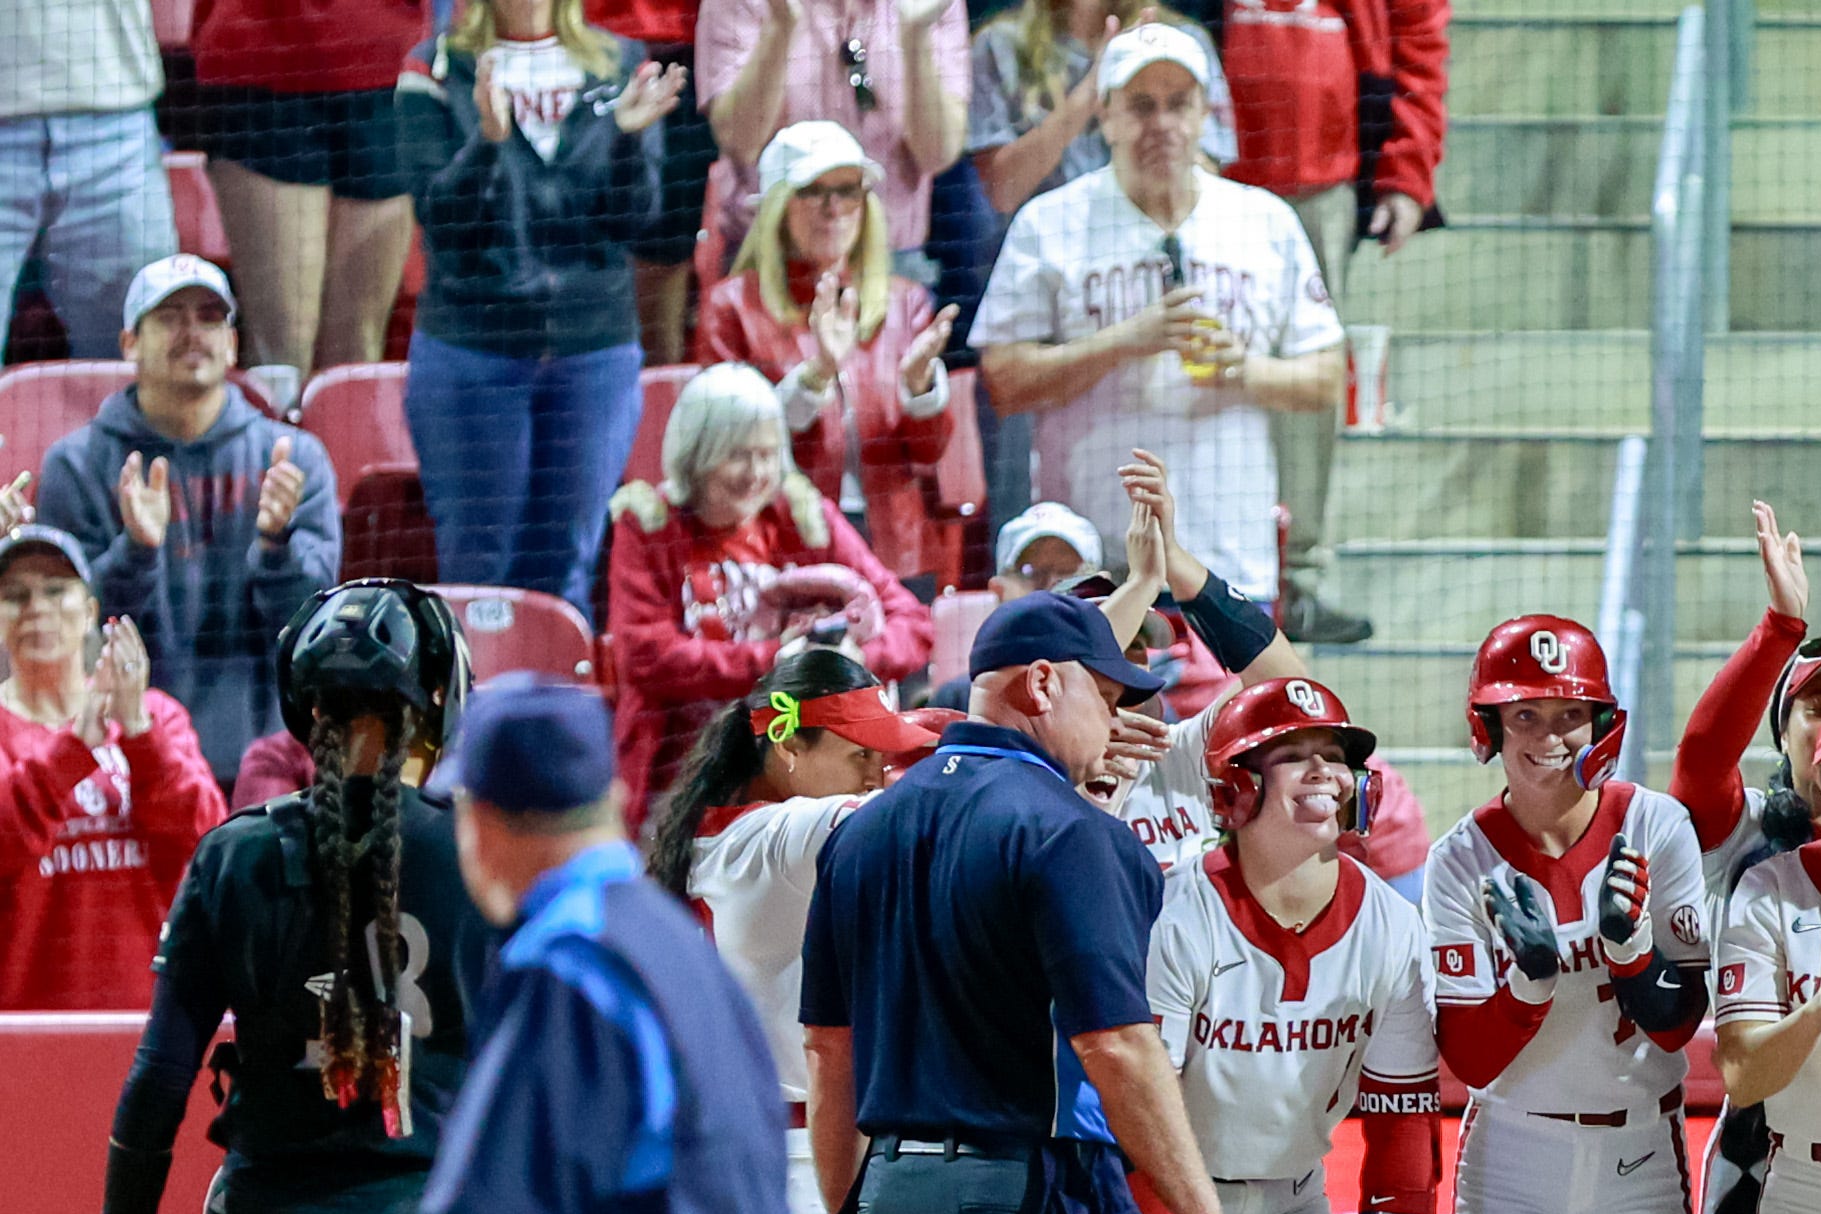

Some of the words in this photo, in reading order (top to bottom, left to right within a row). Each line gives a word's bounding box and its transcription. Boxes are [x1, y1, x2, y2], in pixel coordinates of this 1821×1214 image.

[1530, 629, 1568, 674] OU
[1284, 679, 1327, 717] OU
[1671, 905, 1700, 945] SEC
[1445, 948, 1464, 973] OU
